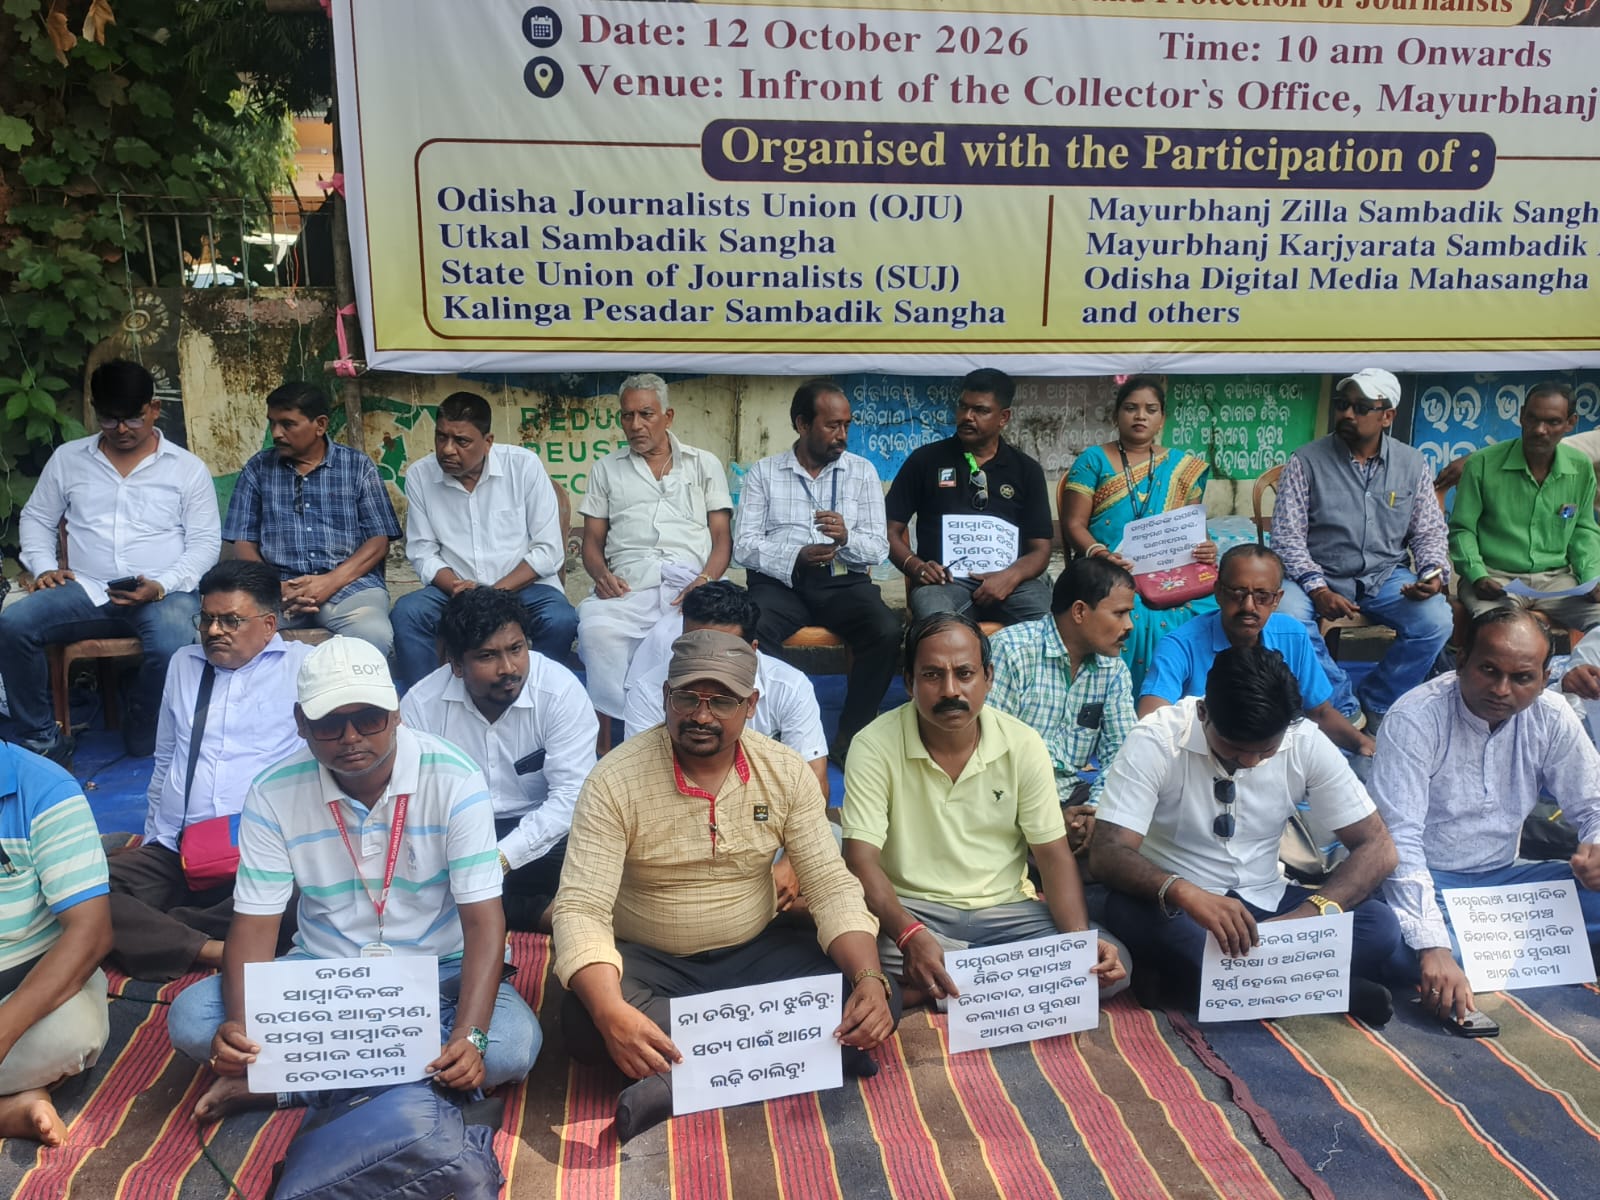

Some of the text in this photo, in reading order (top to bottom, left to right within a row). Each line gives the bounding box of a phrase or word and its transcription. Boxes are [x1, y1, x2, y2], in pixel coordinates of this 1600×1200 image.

[580, 14, 1028, 56] Date: 12 October 2026
[1160, 32, 1551, 67] Time: 10 am Onwards
[578, 64, 722, 97] Venue:
[739, 69, 882, 102] Infront
[898, 74, 939, 102] of
[950, 75, 1009, 104] the
[1238, 82, 1360, 117] Office,
[1377, 84, 1597, 122] Mayurbhanj
[722, 127, 1480, 180] Organised with the Participation of :
[438, 187, 962, 222] Odisha Journalists Union (OJU)
[1090, 198, 1270, 228] Mayurbhanj
[1281, 200, 1346, 222] Zilla
[1359, 200, 1502, 222] Sambadik
[439, 224, 834, 259] Utkal Sambadik Sangha
[1087, 232, 1586, 262] Mayurbhanj Karjyarata Sambadik
[442, 260, 958, 292] State Union of Journalists (SUJ)
[1085, 267, 1588, 295] Odisha Digital Media Mahasangha
[444, 296, 1004, 328] Kalinga Pesadar Sambadik Sangha
[1083, 301, 1239, 323] and others
[523, 440, 630, 462] EUS
[1506, 888, 1567, 905] ସାମ୍ବାଦିକ
[1514, 924, 1574, 941] ସାମ୍ବାଦିକ
[1028, 940, 1087, 957] ସାମ୍ବାଦିକ
[1514, 949, 1525, 958] ଓ
[1528, 945, 1570, 961] ସୁରକ୍ଷା
[316, 967, 370, 979] ଜଣେ
[1220, 958, 1263, 970] ସୁରକ୍ଷା
[1268, 957, 1278, 965] ଓ
[1486, 968, 1520, 978] ଆମର
[1028, 976, 1087, 994] ସାମ୍ବାଦିକ
[1242, 976, 1287, 988] ହେଲେ
[283, 986, 404, 1004] ସାମ୍ବାଦିକଙ୍କ
[1024, 1004, 1035, 1013] ଓ
[1039, 996, 1080, 1014] ସୁରକ୍ଷା
[255, 1010, 333, 1024] ଉପରେ
[678, 1012, 698, 1026] ନା
[759, 1000, 778, 1013] ନା
[264, 1025, 423, 1045] ସମଗ୍ର ସାମ୍ବାଦିକ
[692, 1026, 821, 1056] ସତ୍ୟ ପାଇଁ ଆମେ
[980, 1024, 1024, 1038] ଆମର
[284, 1043, 406, 1062] ସମାଜ ପାଇଁ
